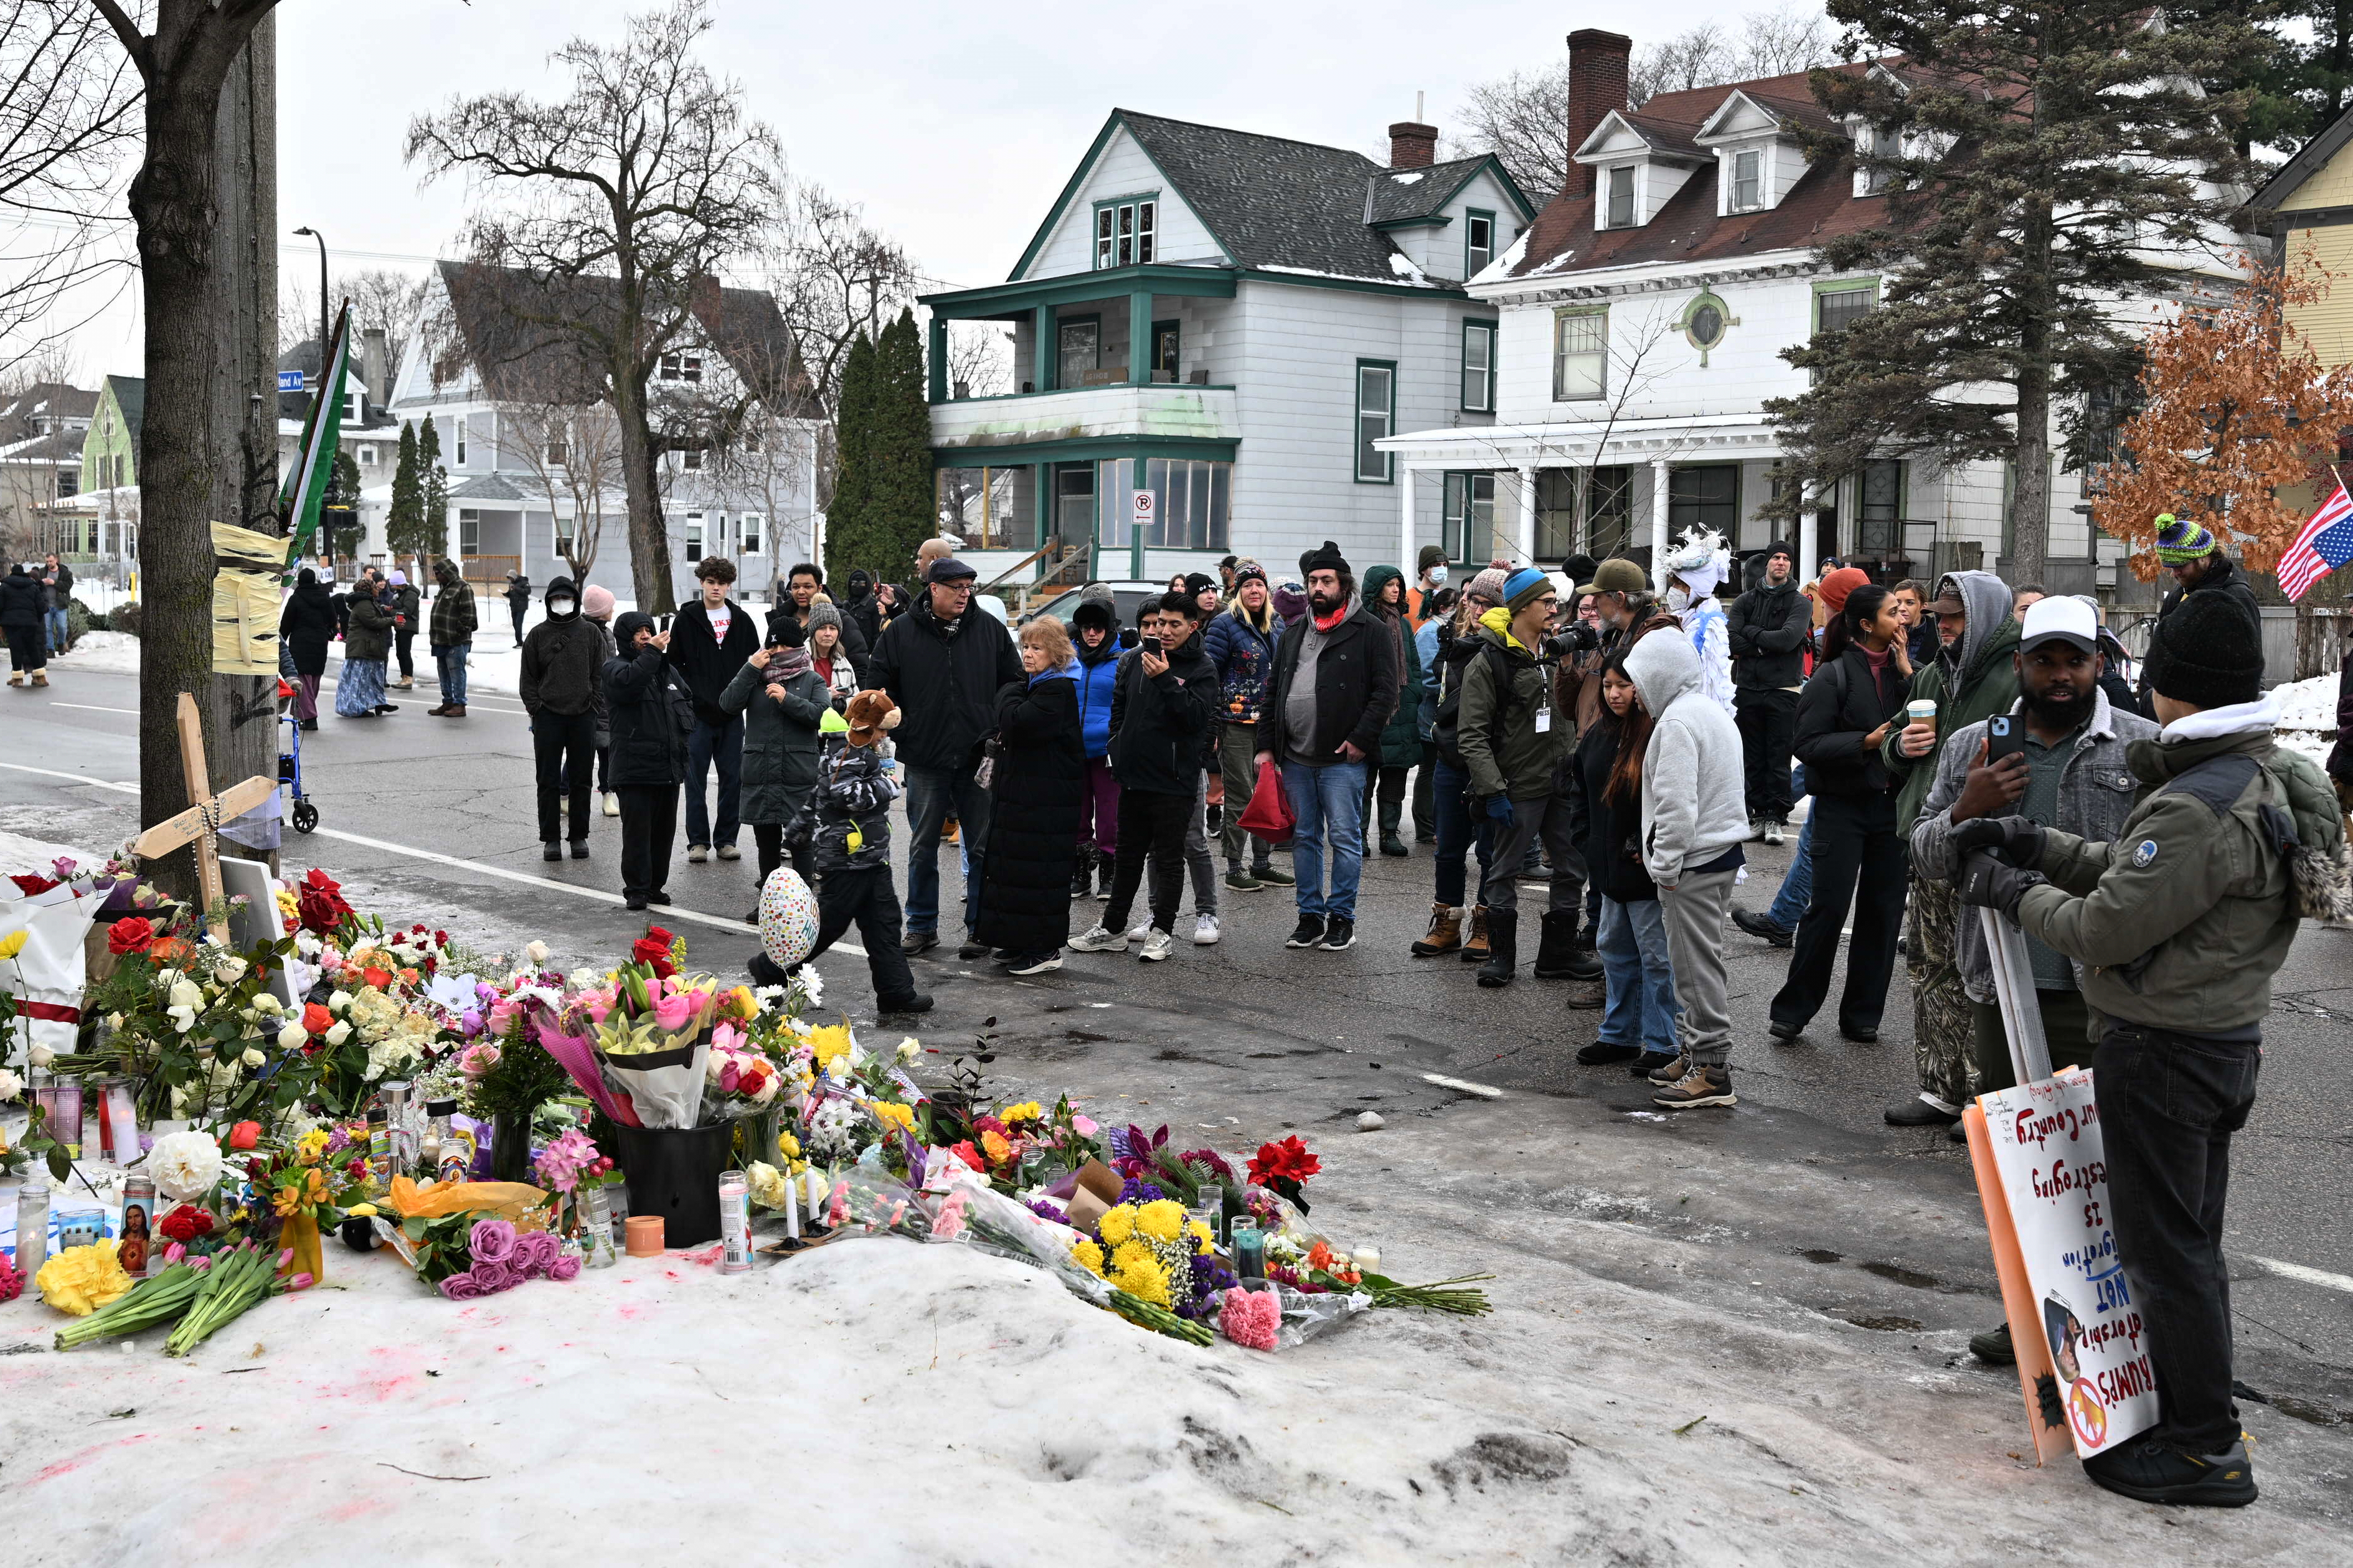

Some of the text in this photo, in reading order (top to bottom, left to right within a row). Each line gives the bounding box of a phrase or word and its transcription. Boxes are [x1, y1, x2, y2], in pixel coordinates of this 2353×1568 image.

[293, 375, 301, 387] Av
[2016, 1108, 2079, 1152] Country
[2032, 1159, 2107, 1205] estroying
[2096, 1272, 2130, 1313] NOT
[2098, 1353, 2158, 1409] RUMP'S
